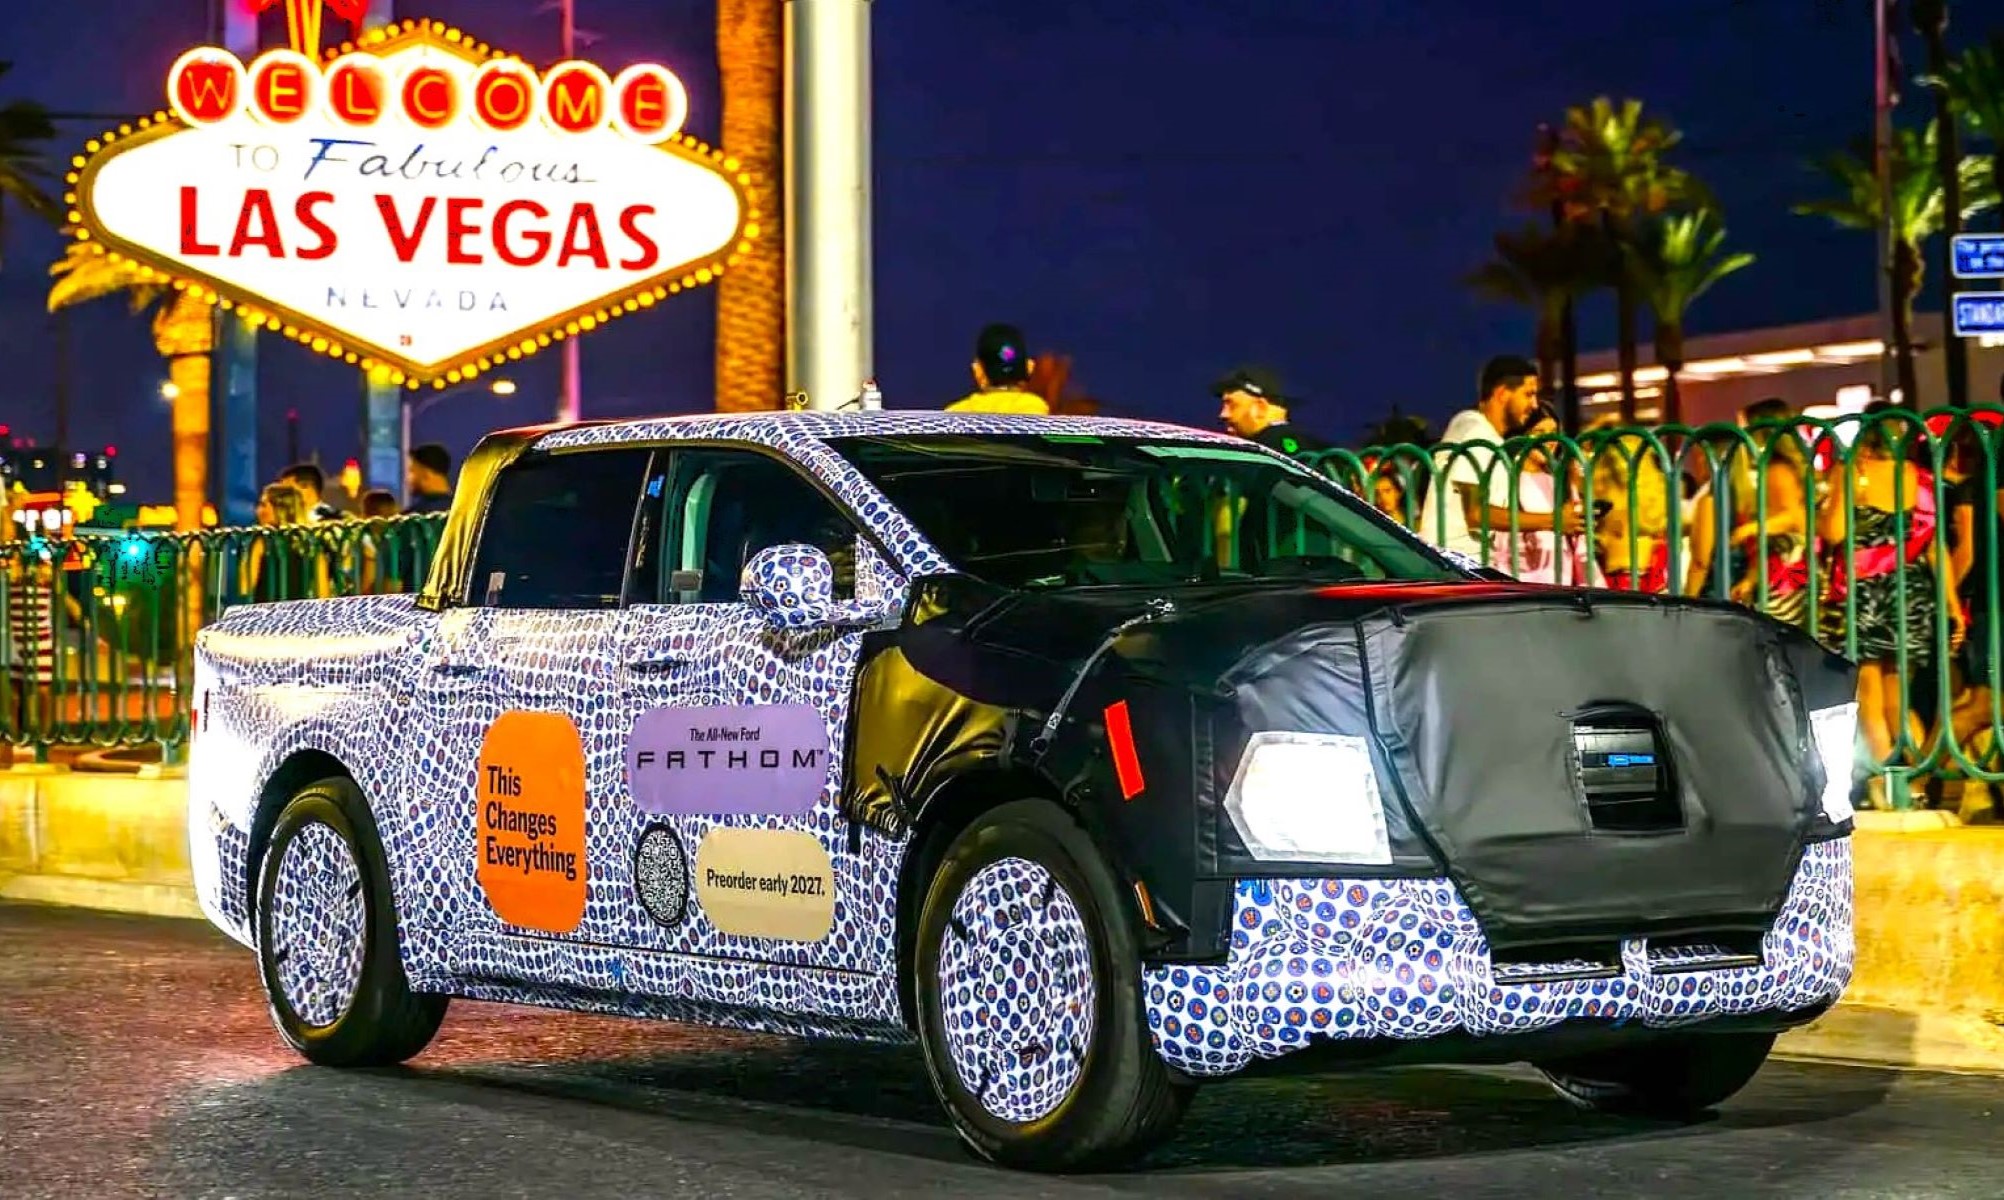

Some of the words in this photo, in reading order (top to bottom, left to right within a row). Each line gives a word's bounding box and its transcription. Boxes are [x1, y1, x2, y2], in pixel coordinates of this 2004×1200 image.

[182, 65, 667, 128] WELCOME
[230, 143, 279, 172] TO
[303, 138, 597, 183] Fabulous
[180, 186, 338, 260] LAS
[372, 192, 661, 271] VEGAS
[326, 286, 507, 311] NEVADA
[689, 727, 705, 742] The
[706, 727, 740, 742] All-New
[740, 727, 761, 742] Ford
[486, 765, 522, 798] This
[485, 800, 557, 841] Changes
[485, 835, 577, 882] Everything
[706, 867, 758, 891] Preorder
[758, 872, 789, 897] early
[790, 874, 826, 897] 2027.
